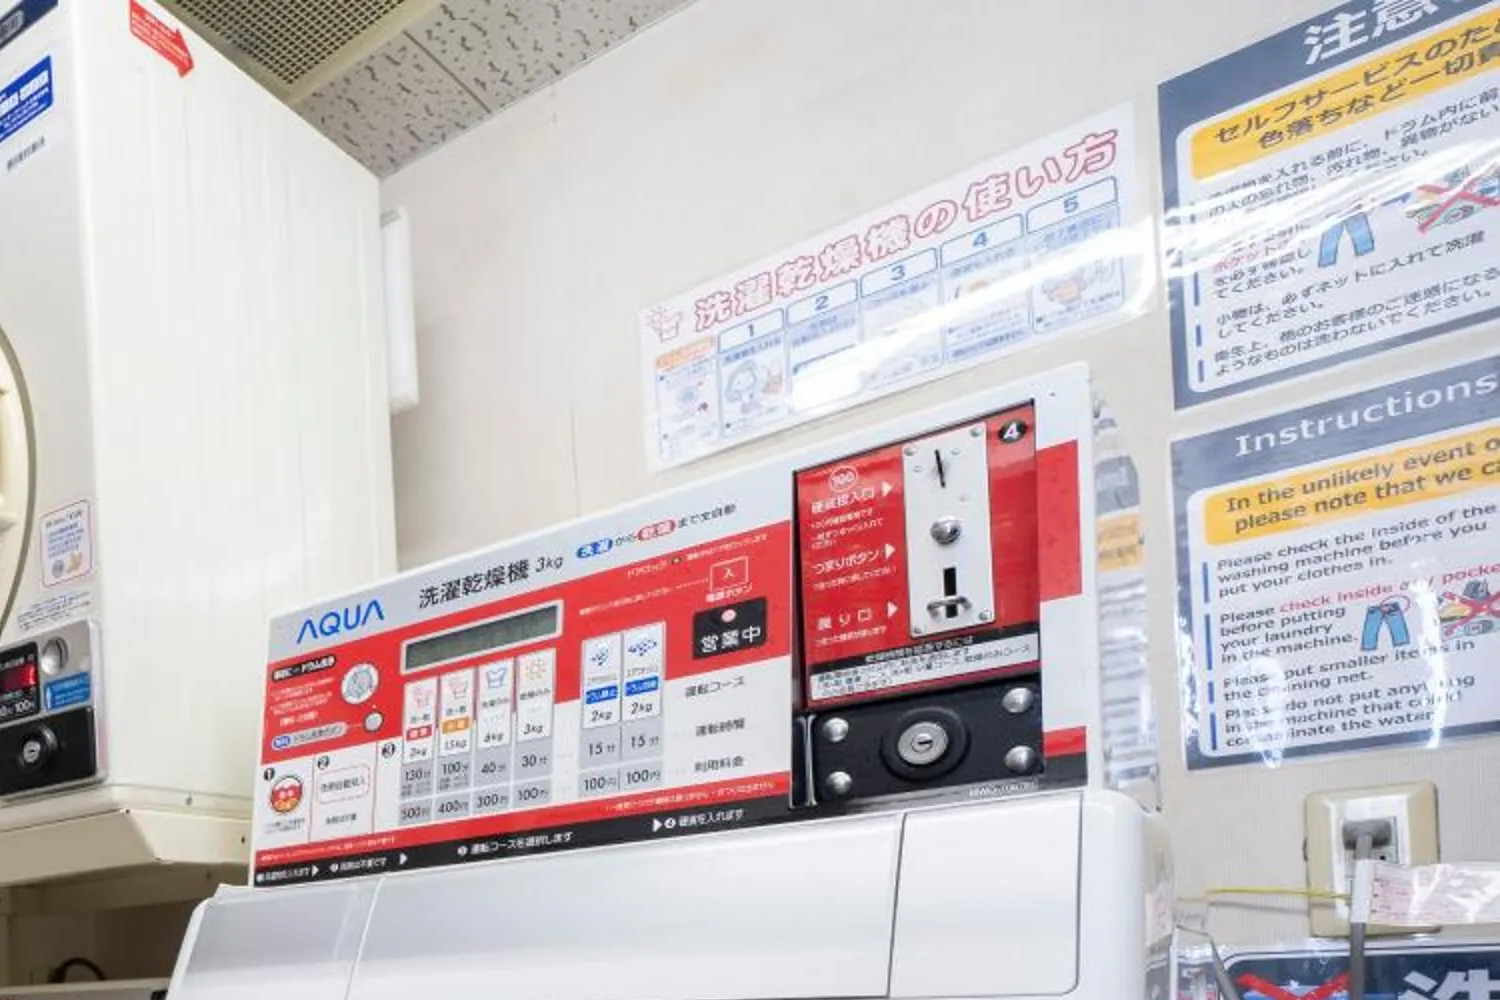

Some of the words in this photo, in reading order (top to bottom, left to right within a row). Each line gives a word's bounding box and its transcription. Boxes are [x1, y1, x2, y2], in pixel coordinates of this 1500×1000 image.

[1063, 195, 1079, 214] 5
[694, 130, 1119, 332] 洗濯乾燥機の使い方
[972, 231, 988, 247] 4
[891, 264, 906, 281] 3
[816, 295, 829, 311] 2
[748, 323, 755, 338] 1
[1235, 373, 1498, 457] Instructions
[1227, 497, 1250, 513] In
[1258, 485, 1295, 504] the
[1302, 462, 1395, 495] unlikely
[1403, 441, 1476, 471] event
[1235, 504, 1308, 534] please
[1315, 491, 1367, 512] note
[1375, 474, 1427, 499] that
[1435, 466, 1473, 484] we
[1217, 550, 1273, 571] Please
[1278, 539, 1329, 558] check
[1335, 529, 1366, 546] the
[1371, 518, 1430, 539] inside
[1435, 510, 1456, 527] of
[1462, 502, 1498, 519] the
[1217, 562, 1290, 585] washing
[1295, 544, 1373, 568] machine
[1380, 531, 1443, 551] before
[1450, 521, 1488, 539] you
[419, 559, 530, 609] 洗濯乾燥機
[535, 556, 565, 573] 3kg
[1219, 584, 1247, 600] put
[1253, 575, 1292, 594] your
[1297, 561, 1364, 581] clothes
[1220, 605, 1276, 625] Please
[1280, 596, 1331, 614] check
[1337, 584, 1394, 603] inside
[297, 599, 385, 645] AQUA
[1221, 618, 1277, 637] before
[1280, 606, 1347, 629] putting
[700, 626, 761, 653] 営業中
[1220, 635, 1258, 653] your
[1265, 623, 1334, 647] laundry
[1221, 652, 1238, 664] in
[1276, 633, 1359, 655] machine.
[1284, 664, 1313, 681] put
[1319, 653, 1389, 674] smaller
[1456, 638, 1475, 652] in
[1224, 687, 1252, 702] the
[1337, 671, 1375, 686] net.
[1285, 698, 1308, 711] do
[1313, 692, 1342, 707] not
[1350, 688, 1381, 704] put
[590, 709, 613, 722] 2kg
[630, 702, 653, 716] 2kg
[1363, 700, 1402, 716] that
[695, 717, 746, 737] 運転時間
[1341, 718, 1374, 733] the
[583, 776, 618, 791] 100円
[626, 769, 662, 785] 100円
